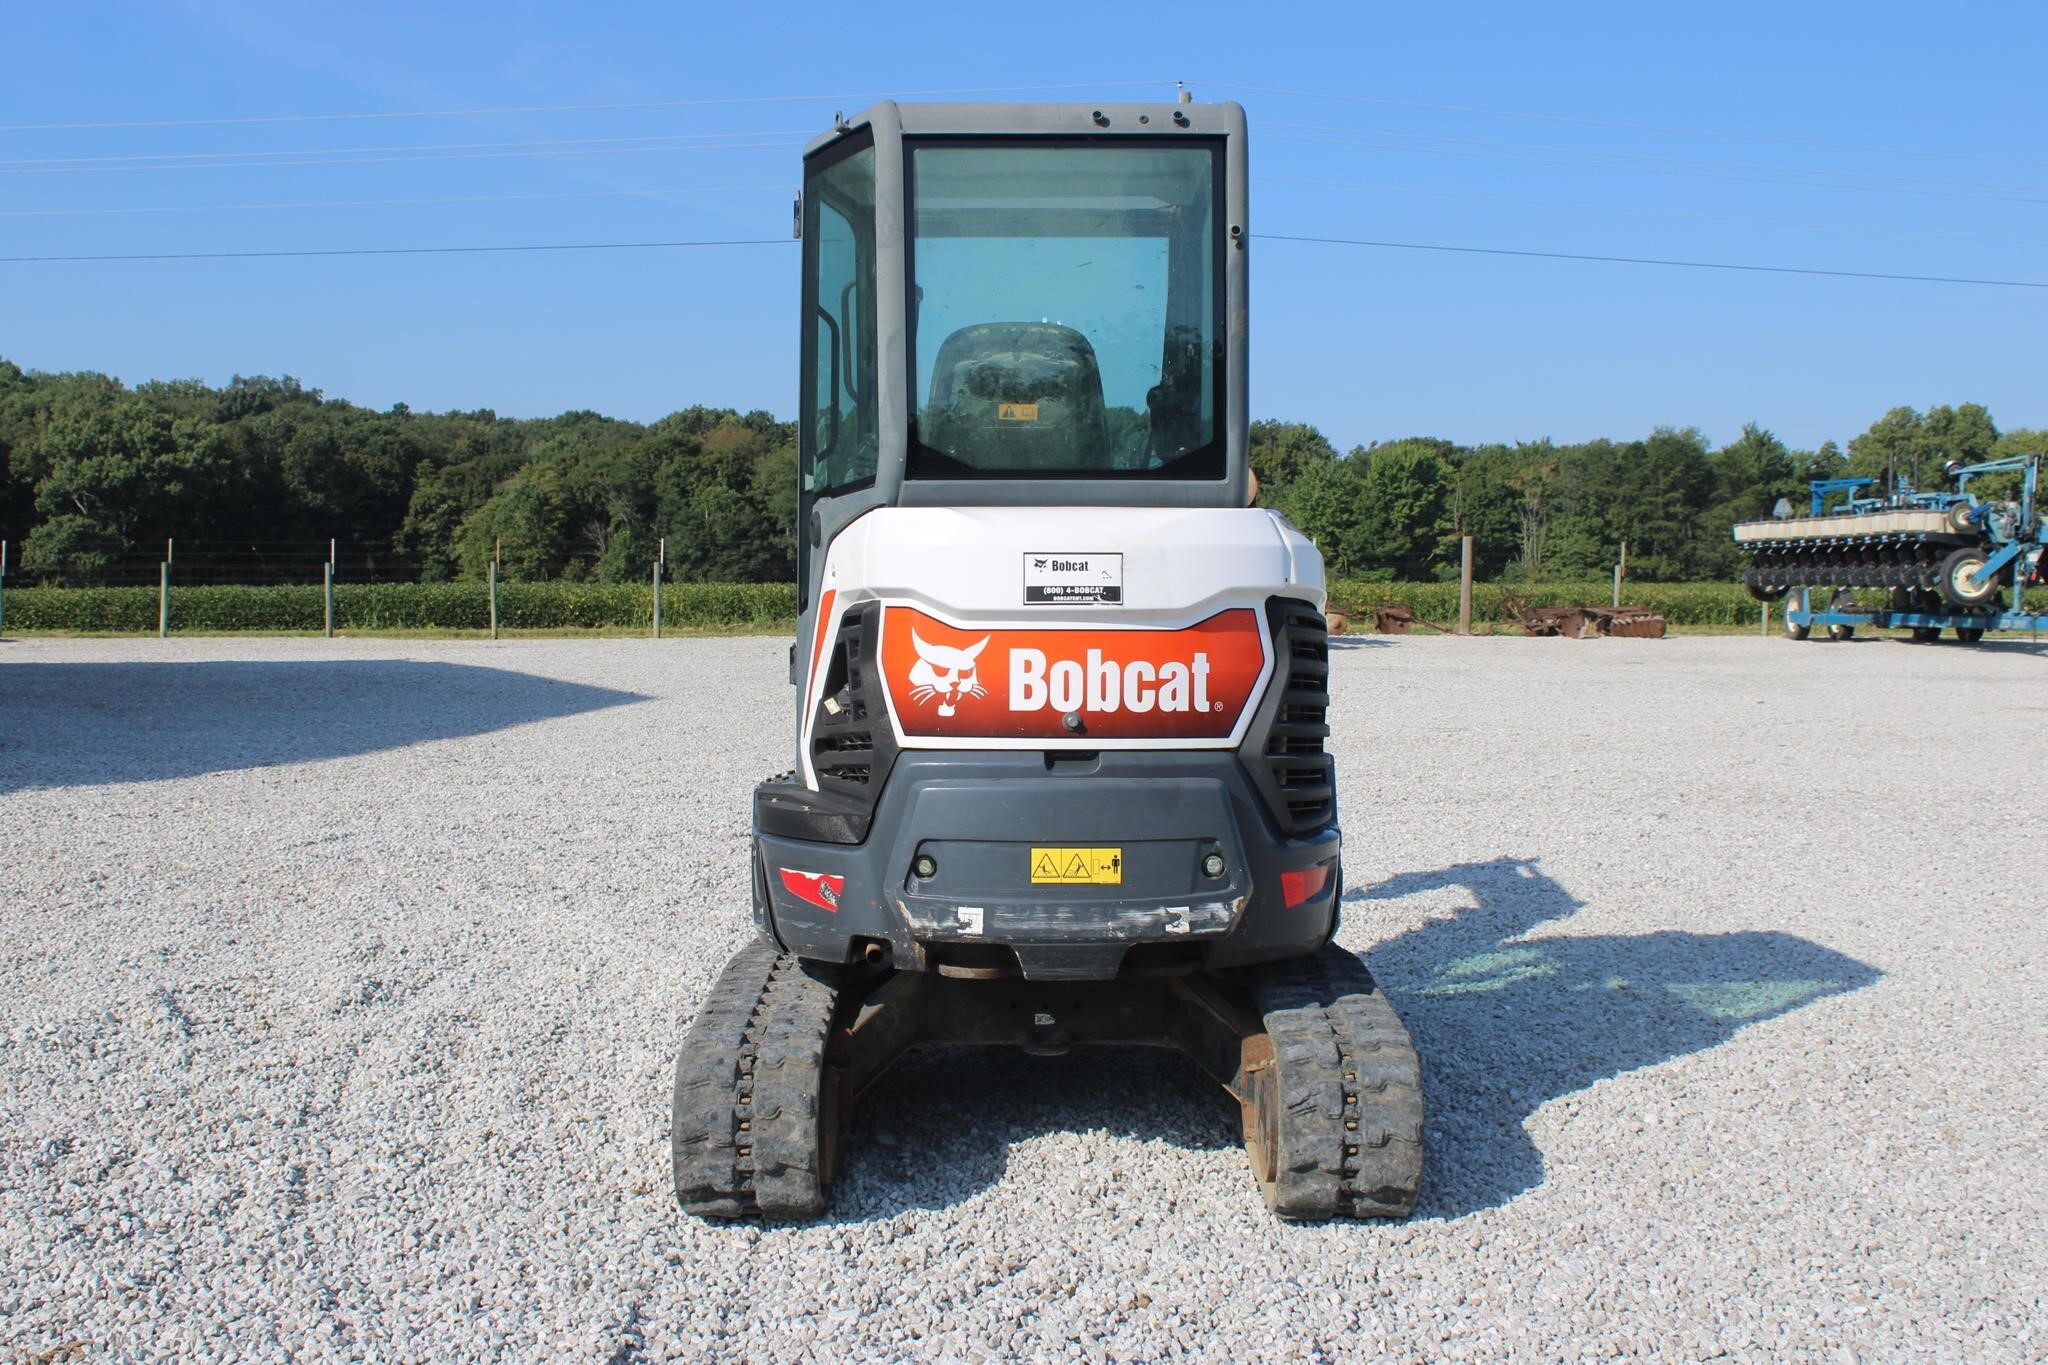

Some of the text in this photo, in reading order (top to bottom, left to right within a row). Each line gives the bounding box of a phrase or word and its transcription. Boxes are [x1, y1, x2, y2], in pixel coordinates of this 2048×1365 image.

[1052, 560, 1088, 572] Bobcat
[1043, 586, 1064, 595] (800)
[1009, 648, 1210, 713] Bobcat
